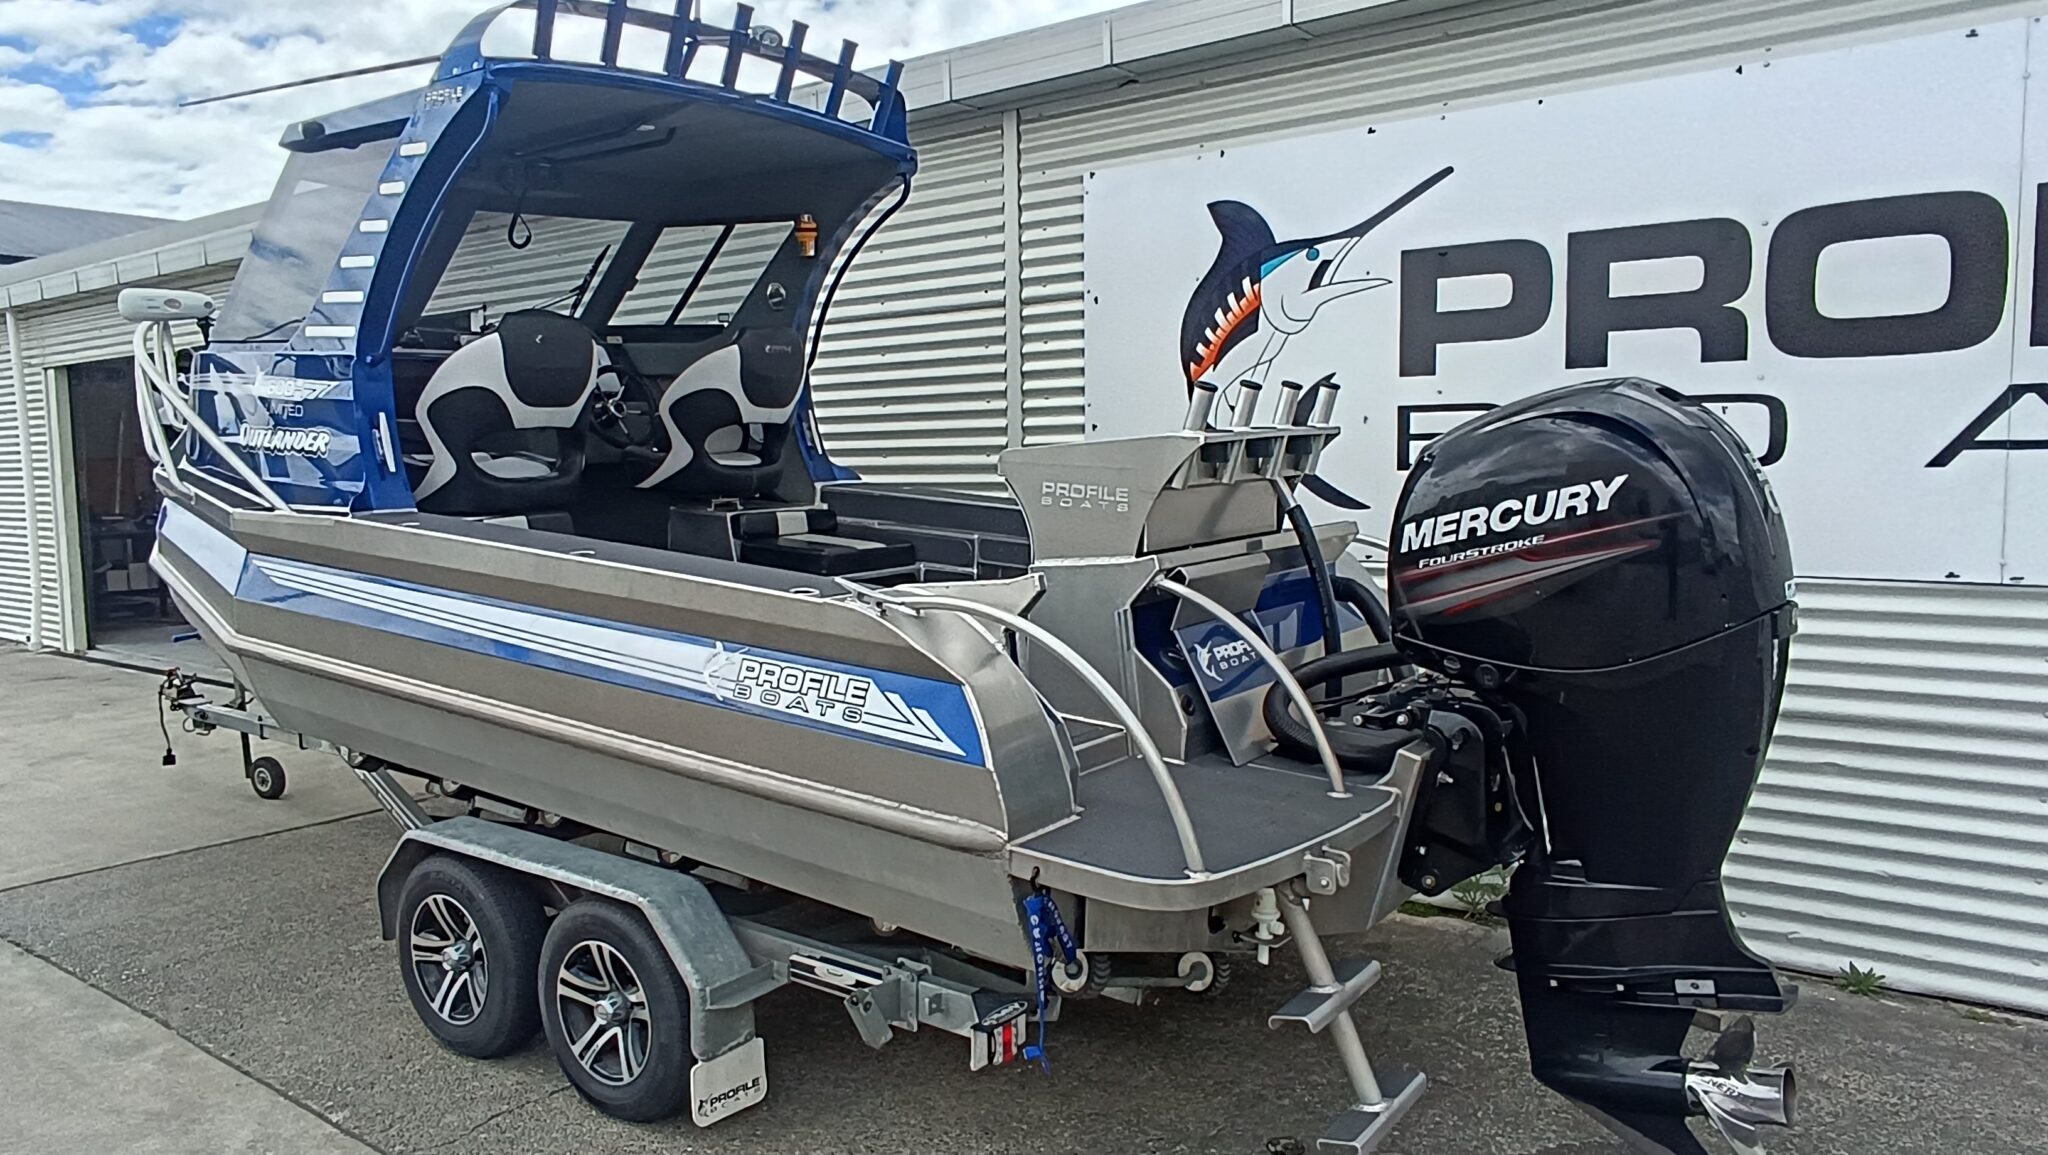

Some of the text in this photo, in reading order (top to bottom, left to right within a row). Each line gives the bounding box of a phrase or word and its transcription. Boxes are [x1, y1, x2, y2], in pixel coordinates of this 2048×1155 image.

[1399, 182, 2048, 377] PRO
[1041, 496, 1129, 512] BOATS
[1042, 481, 1129, 502] PROFILE
[1400, 474, 1629, 553] MERCURY
[1220, 651, 1256, 670] BOAT
[737, 658, 871, 707] PROFILE
[733, 683, 863, 723] BOATS
[710, 1076, 761, 1107] PROFILE
